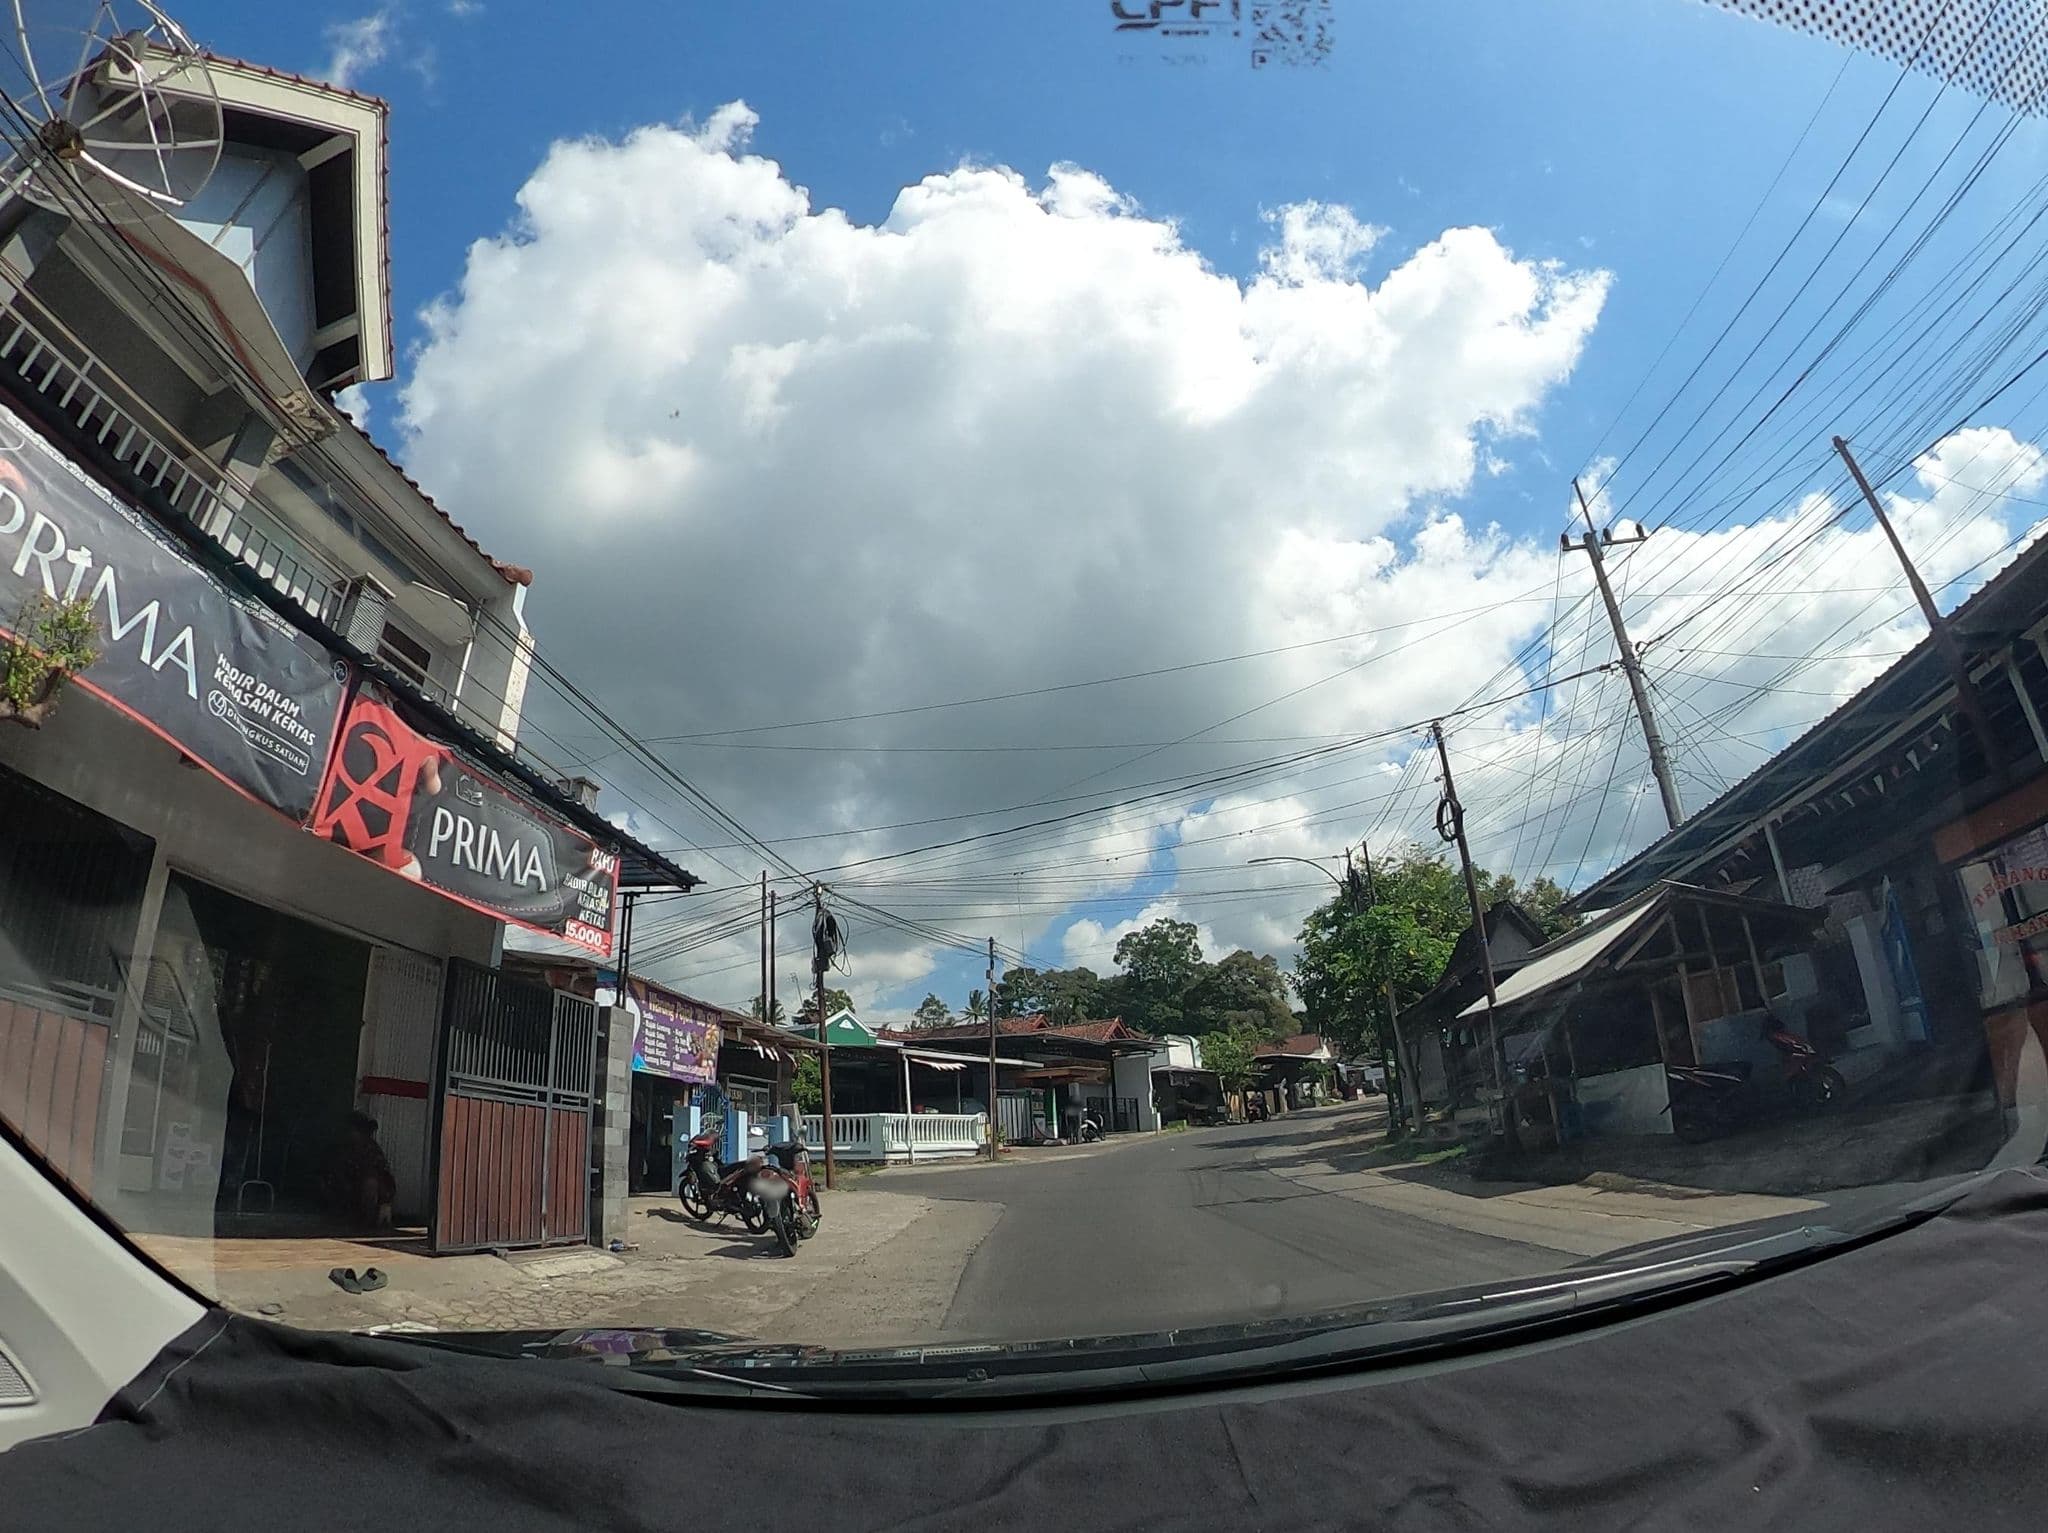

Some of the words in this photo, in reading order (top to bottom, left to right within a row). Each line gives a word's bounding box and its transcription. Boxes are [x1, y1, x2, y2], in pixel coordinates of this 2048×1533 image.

[214, 666, 273, 718] KEMASAN
[271, 710, 316, 746] KERTAS
[218, 653, 255, 690] HADIR
[255, 683, 300, 718] DALAM
[273, 744, 306, 768] SATUAN
[428, 806, 548, 892] PRIMA
